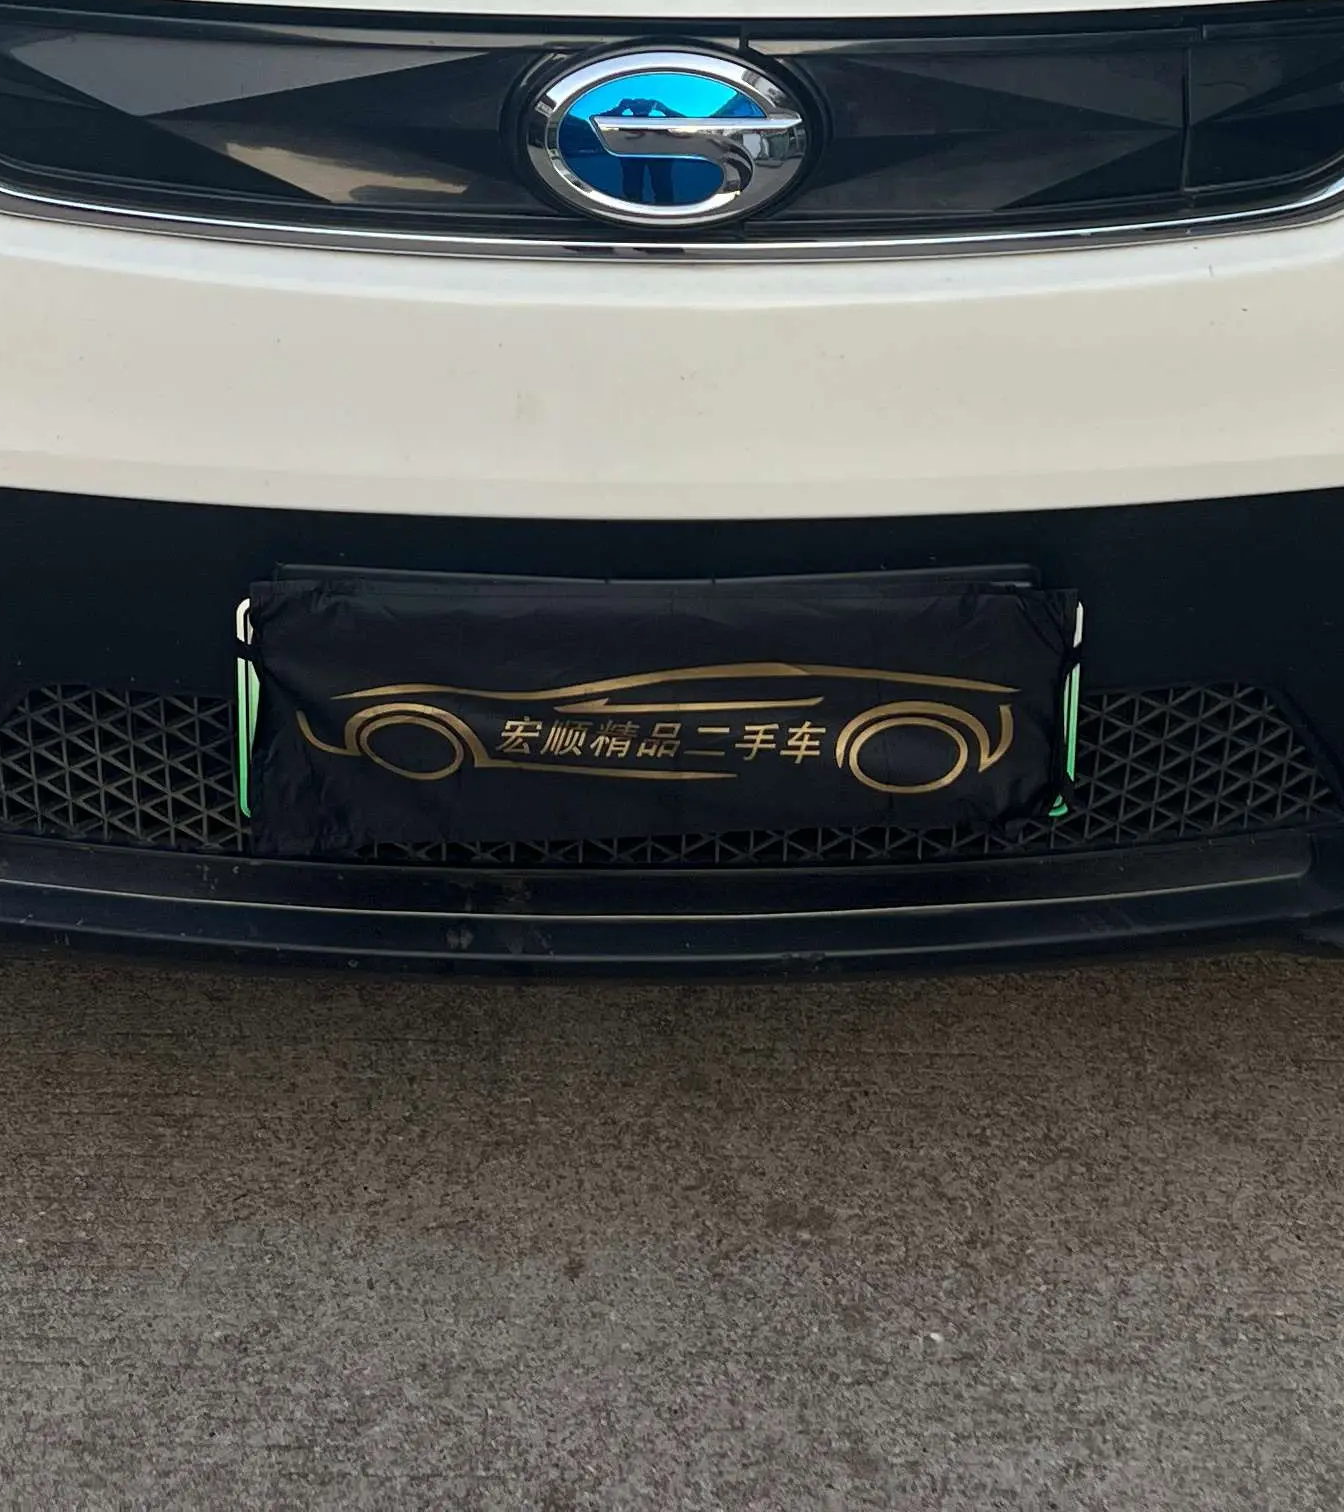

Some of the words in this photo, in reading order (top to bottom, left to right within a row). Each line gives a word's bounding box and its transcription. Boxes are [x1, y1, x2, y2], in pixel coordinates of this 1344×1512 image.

[497, 716, 827, 764] 宏顺精品二手车
